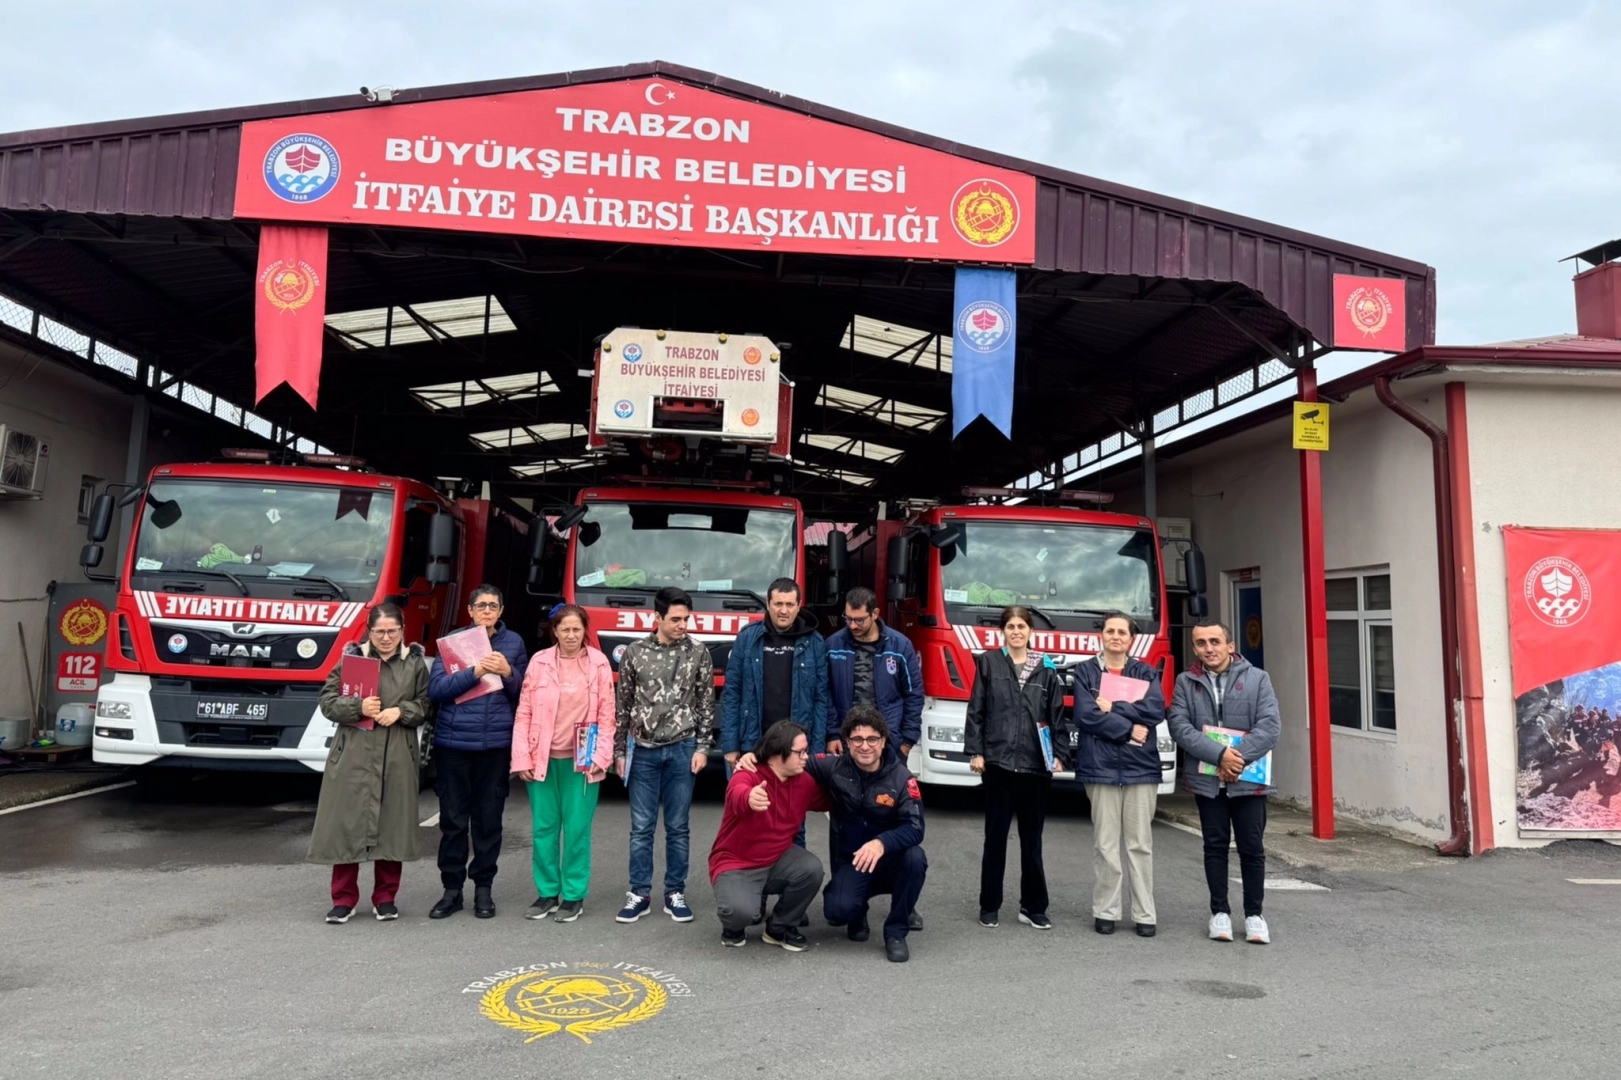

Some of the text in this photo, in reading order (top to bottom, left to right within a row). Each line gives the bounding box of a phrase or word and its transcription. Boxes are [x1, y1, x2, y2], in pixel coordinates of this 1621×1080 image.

[556, 107, 750, 143] TRABZON
[266, 145, 283, 174] TRABZON
[385, 135, 905, 194] BÜYÜKŞEHİR BELEDİYESİ
[353, 171, 939, 245] İTFAİYE DAİRESİ BAŞKANLIĞI
[665, 346, 719, 361] TRABZON
[700, 366, 765, 382] BELEDİYESİ
[664, 381, 718, 397] İTFAİYESİ
[210, 643, 271, 658] MAN
[65, 655, 96, 675] 112
[205, 702, 266, 716] 61 ABF 465
[461, 961, 568, 994] TRABZON
